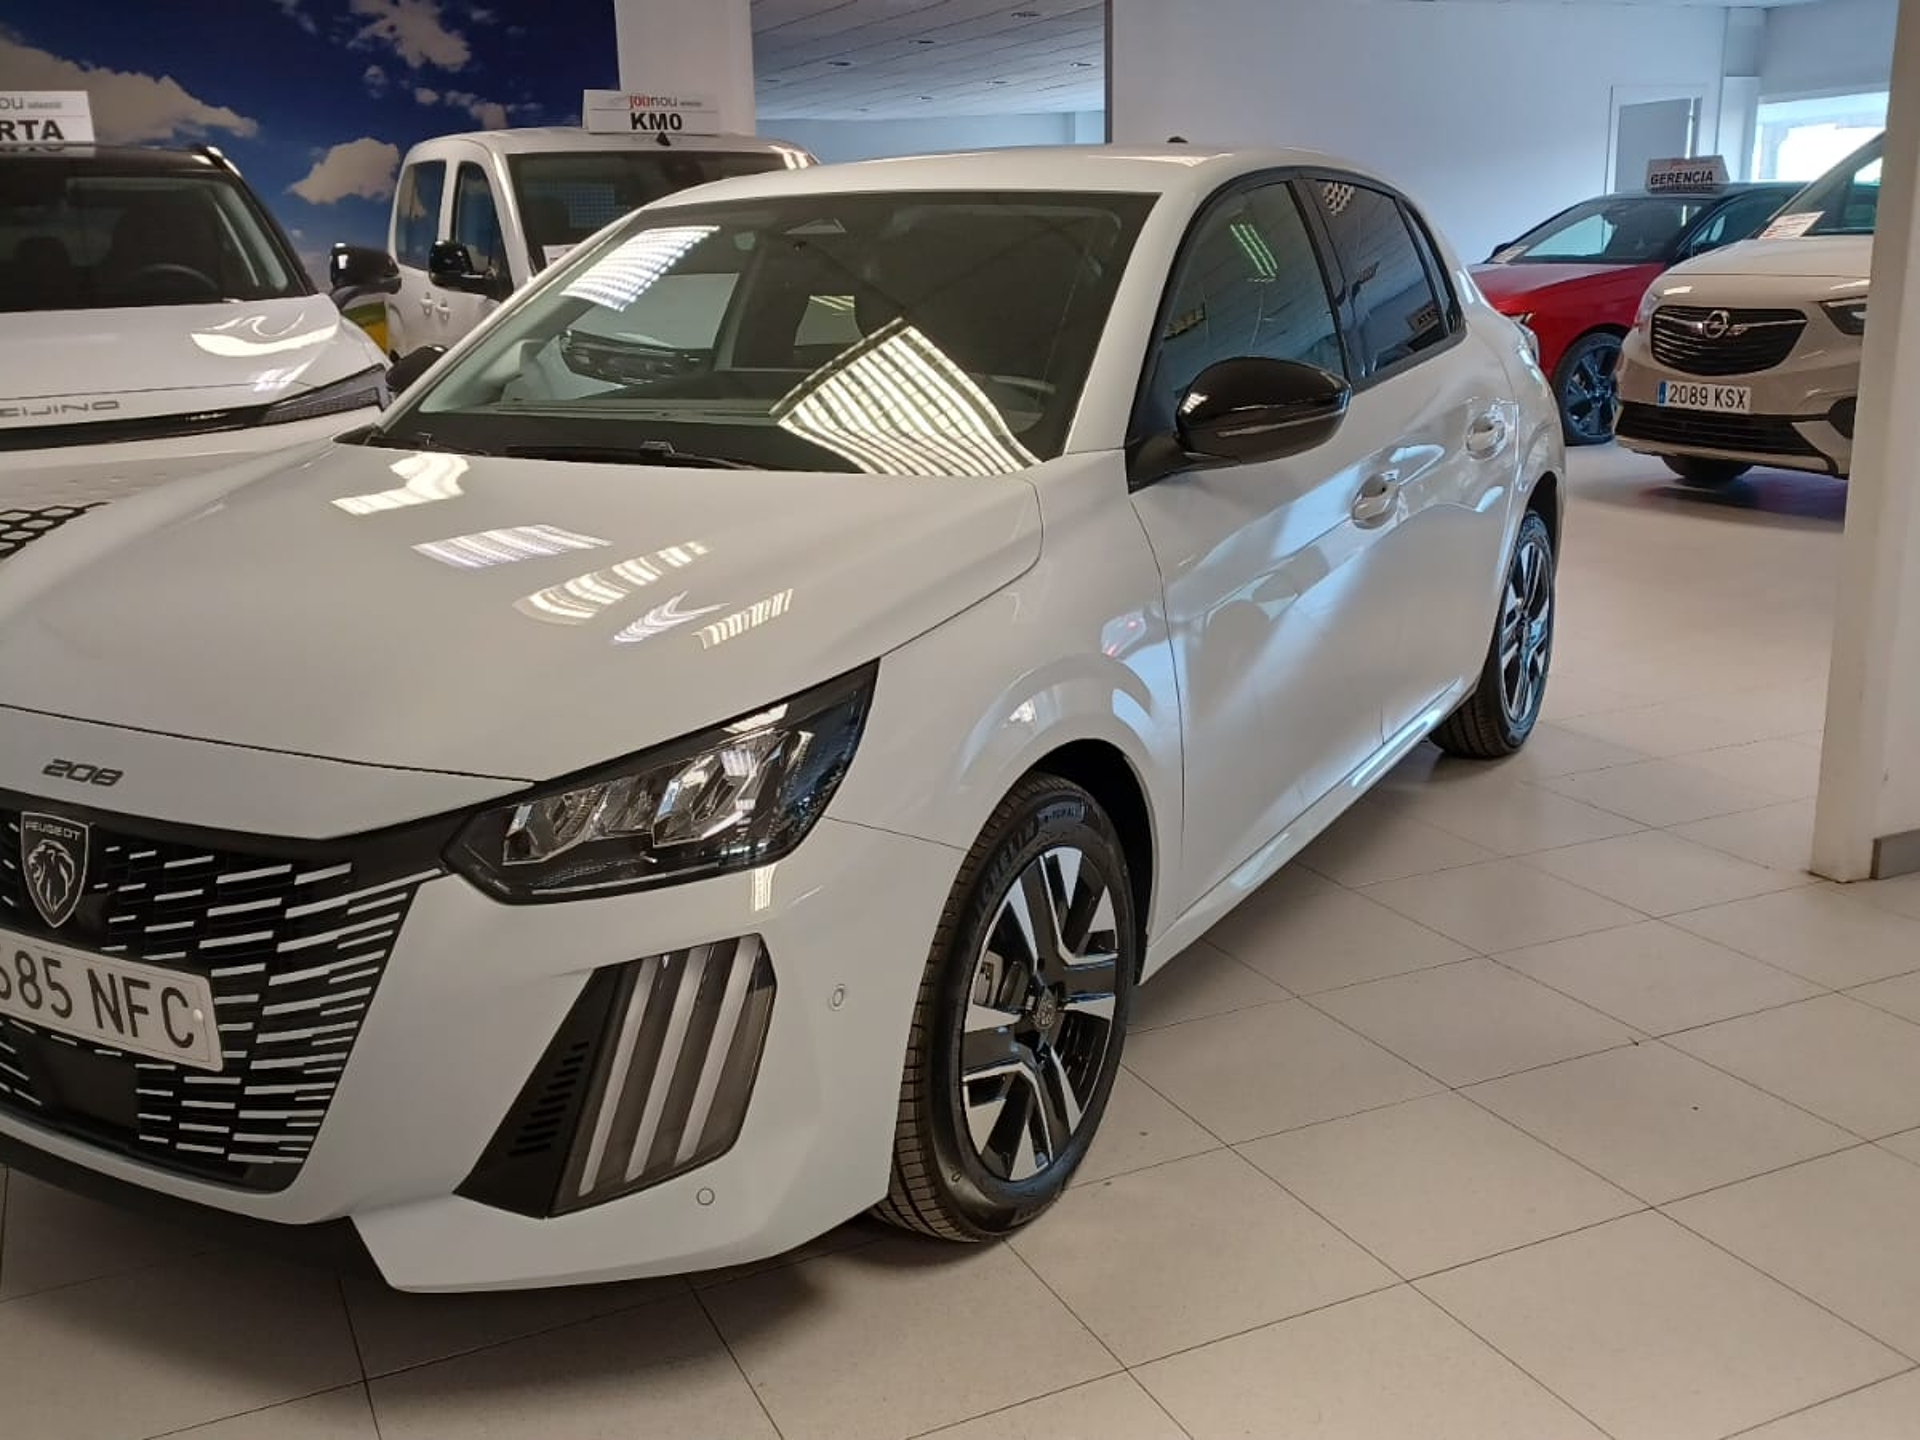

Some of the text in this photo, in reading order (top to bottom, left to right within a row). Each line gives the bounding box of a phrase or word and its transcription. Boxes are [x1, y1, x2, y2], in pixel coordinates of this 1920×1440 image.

[1650, 171, 1714, 185] GERENCIA
[1668, 384, 1747, 409] 2089 KSX
[42, 758, 124, 787] 208
[24, 821, 81, 841] PEUGEOT
[87, 967, 195, 1048] NFC
